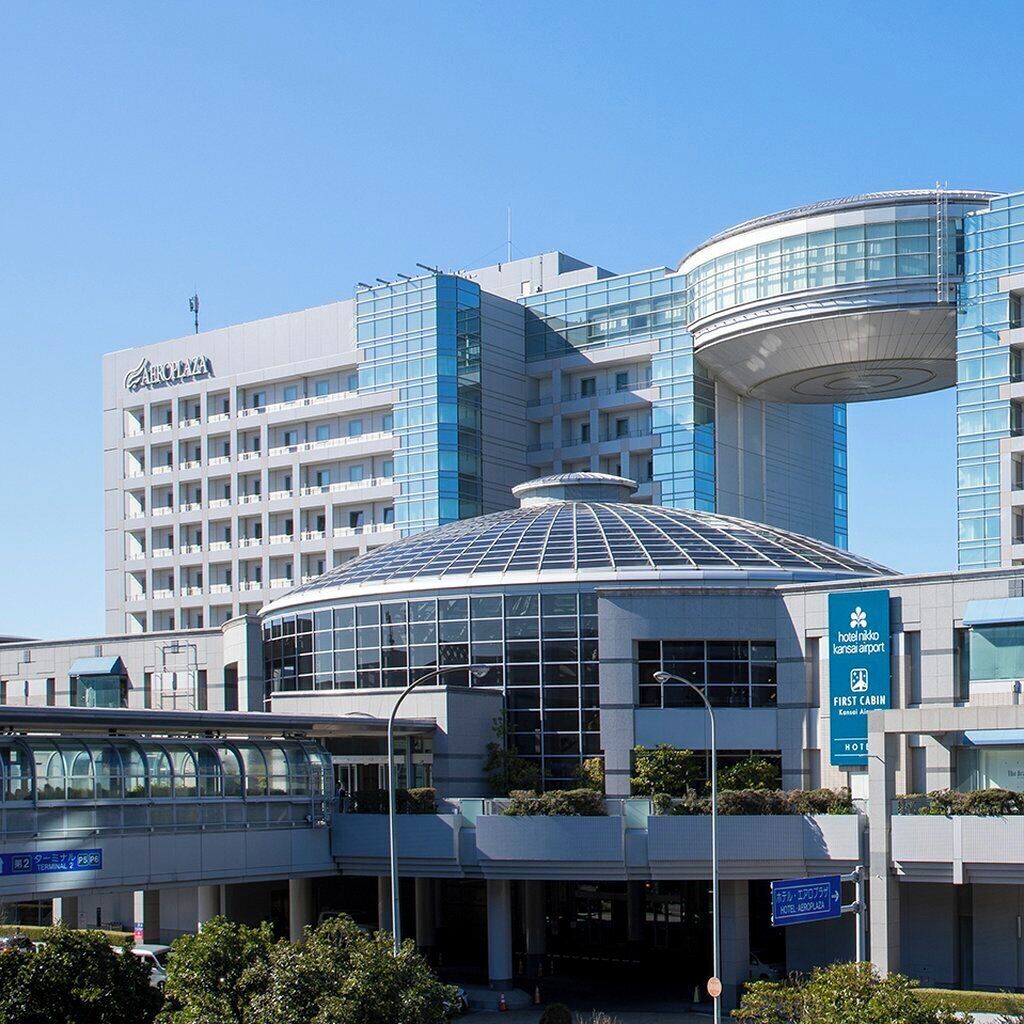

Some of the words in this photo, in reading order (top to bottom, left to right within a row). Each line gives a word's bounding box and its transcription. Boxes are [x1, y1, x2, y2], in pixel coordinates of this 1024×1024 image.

[140, 354, 208, 385] AEROPLAZA
[838, 630, 858, 643] hotel
[858, 629, 880, 641] nikko
[832, 641, 858, 655] kansai
[858, 641, 886, 655] airport
[833, 695, 857, 707] FIRST
[859, 694, 886, 706] CABIN
[838, 708, 858, 716] Kansai
[845, 742, 869, 752] HOTE
[34, 853, 76, 864] ターミナル
[37, 862, 67, 871] TERMINAL
[69, 861, 74, 869] 2
